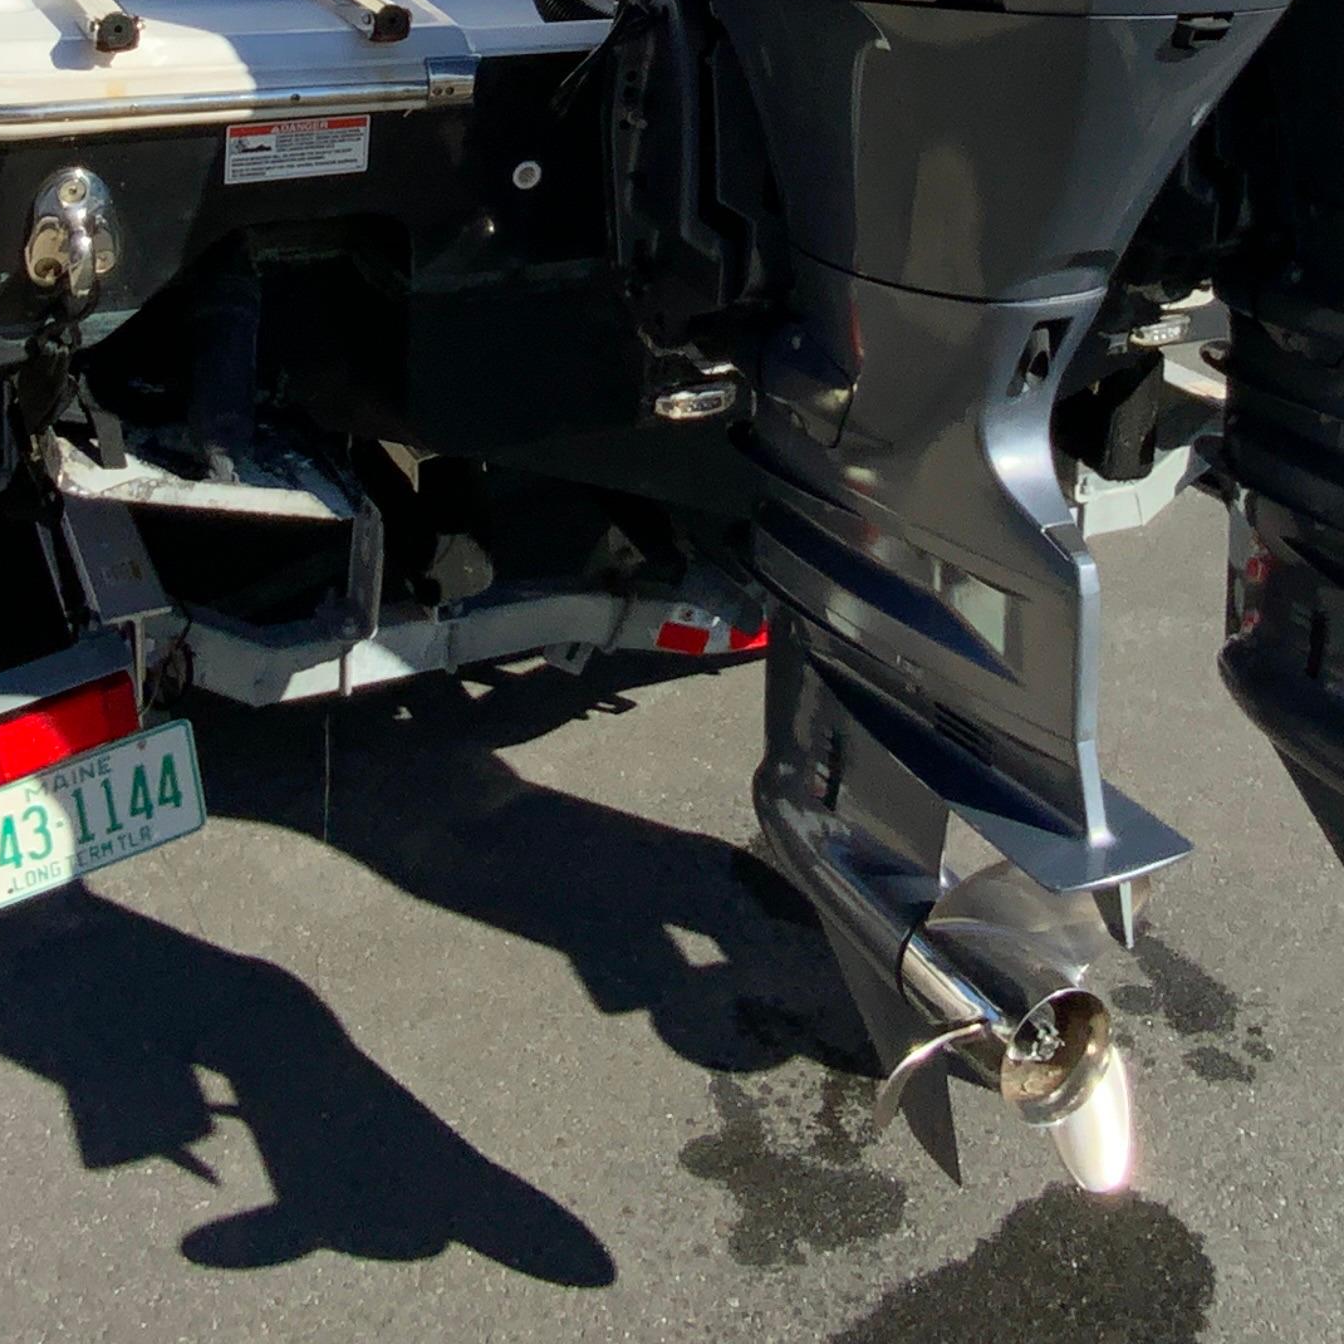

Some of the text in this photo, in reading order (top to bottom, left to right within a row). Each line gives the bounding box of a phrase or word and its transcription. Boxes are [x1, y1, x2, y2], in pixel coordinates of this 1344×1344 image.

[280, 121, 329, 134] DANGER
[25, 757, 113, 802] MAINE
[13, 825, 153, 892] LONG TERM TLR
